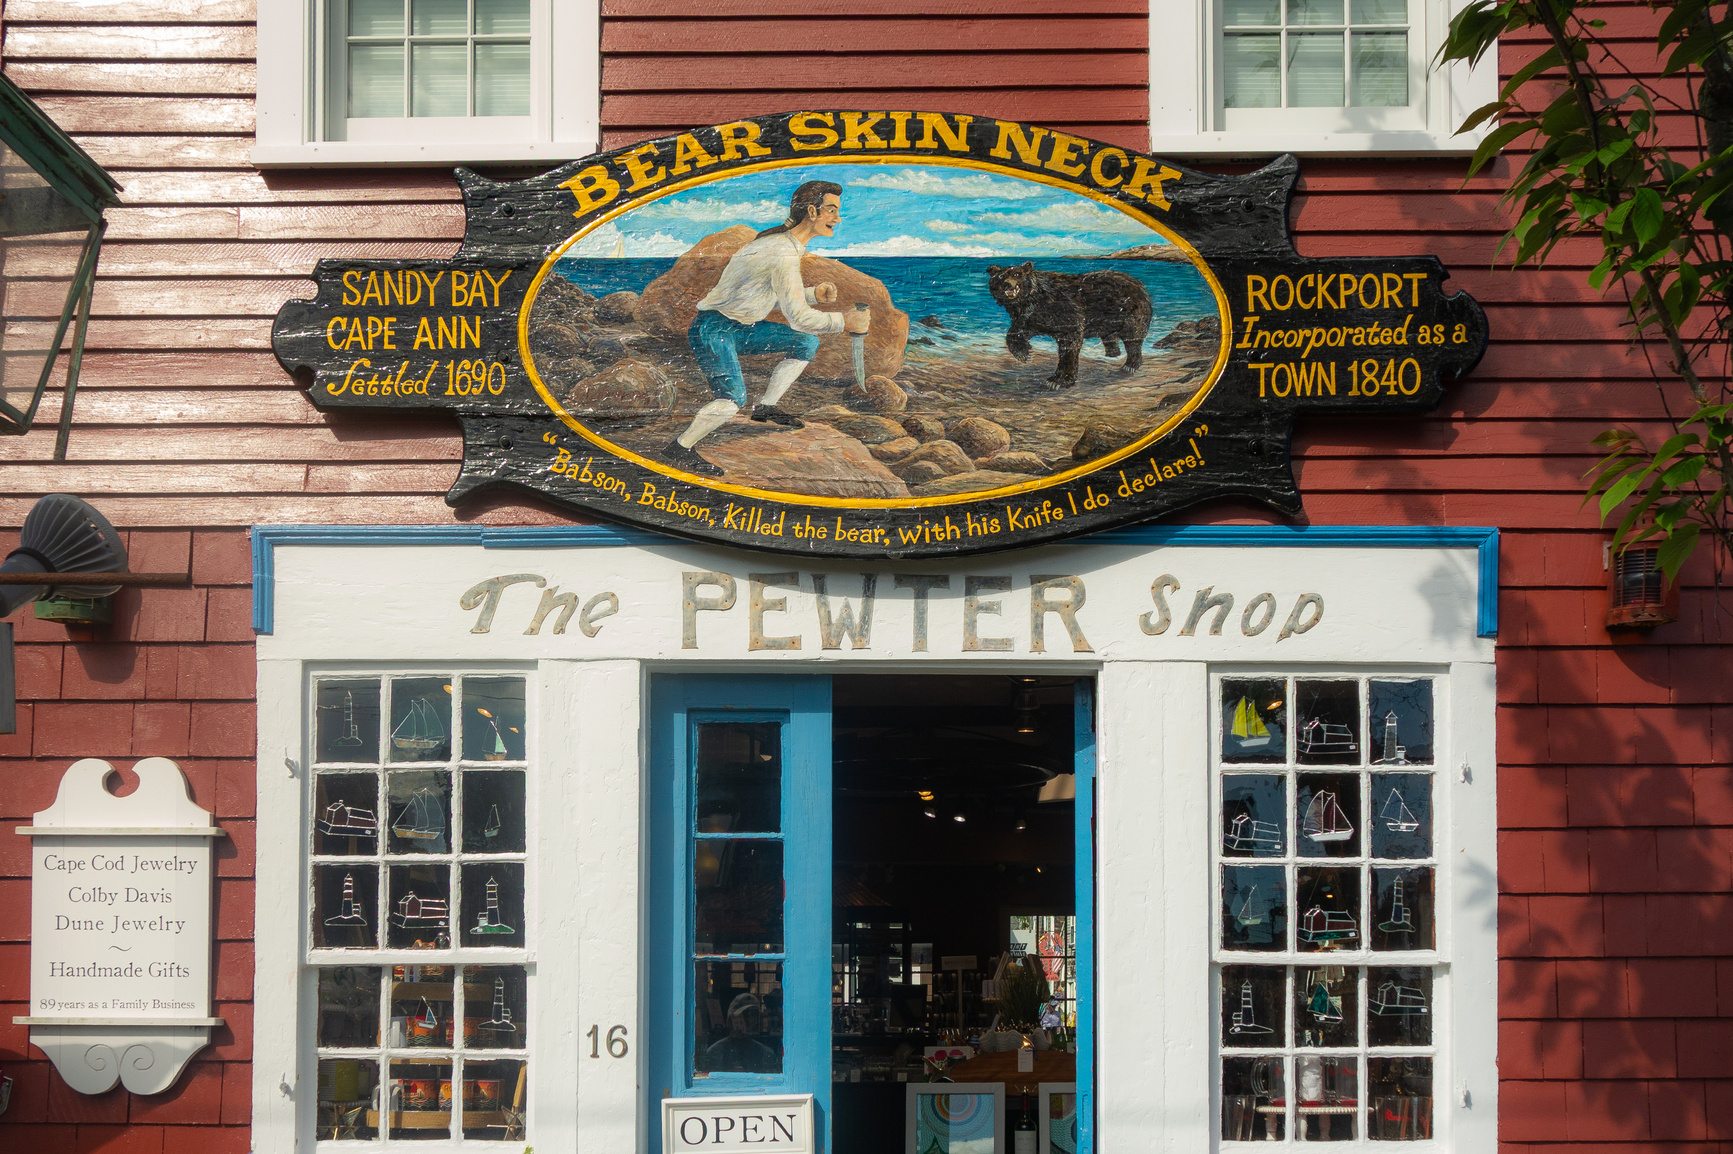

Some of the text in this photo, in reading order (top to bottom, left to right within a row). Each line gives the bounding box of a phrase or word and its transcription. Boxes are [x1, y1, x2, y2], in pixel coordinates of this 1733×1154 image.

[558, 111, 1183, 218] BEAR SKIN NECK
[342, 269, 513, 307] SANDY BAY
[1247, 272, 1427, 312] ROCKPORT
[326, 315, 481, 350] CAPE ANN
[1236, 314, 1468, 358] Incorporated as a
[326, 358, 506, 398] Settled 1690
[1248, 357, 1422, 398] TOWN 1840
[636, 482, 715, 527] Babson,
[724, 503, 785, 537] Killed
[792, 515, 827, 540] the
[834, 516, 891, 546] bear,
[966, 512, 1001, 536] his
[1006, 499, 1064, 532] Knife
[1067, 491, 1078, 515] I
[1083, 485, 1110, 511] do
[681, 571, 1095, 654] PEWTER
[43, 854, 198, 874] Cape Cod Jewelry
[68, 886, 173, 906] Colby Davis
[54, 915, 186, 934] Dune Jewelry
[49, 961, 190, 978] Handmade Gifts
[39, 998, 196, 1012] 89 years as a Family Business
[586, 1023, 629, 1059] 16
[680, 1114, 797, 1146] OPEN
